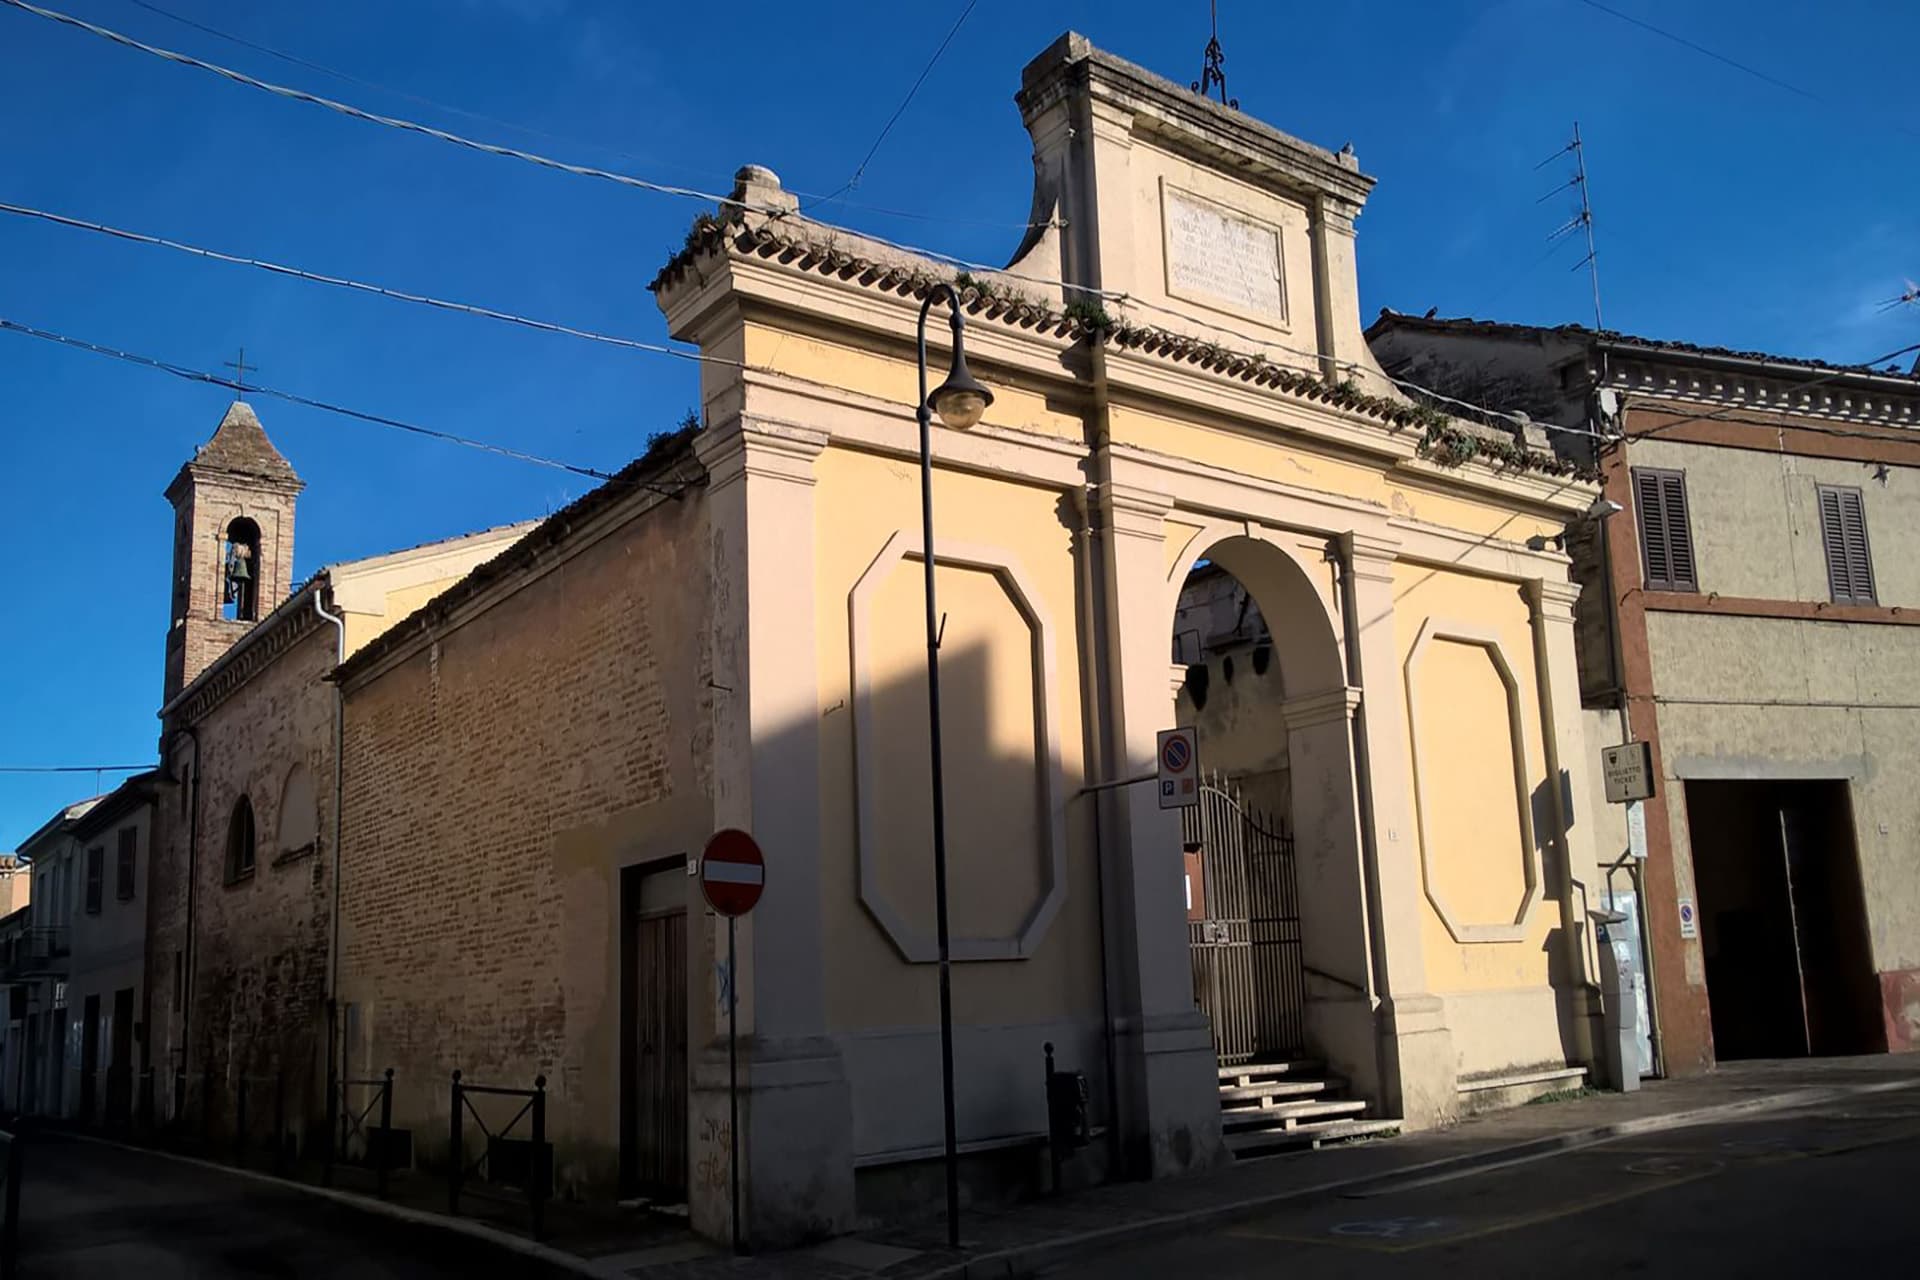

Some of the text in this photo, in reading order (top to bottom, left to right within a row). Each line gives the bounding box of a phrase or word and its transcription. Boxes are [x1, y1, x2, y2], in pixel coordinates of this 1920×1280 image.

[1608, 766, 1641, 777] BIGLIETTO
[1614, 775, 1637, 784] TICKET
[1165, 782, 1172, 794] P
[1597, 926, 1605, 941] P
